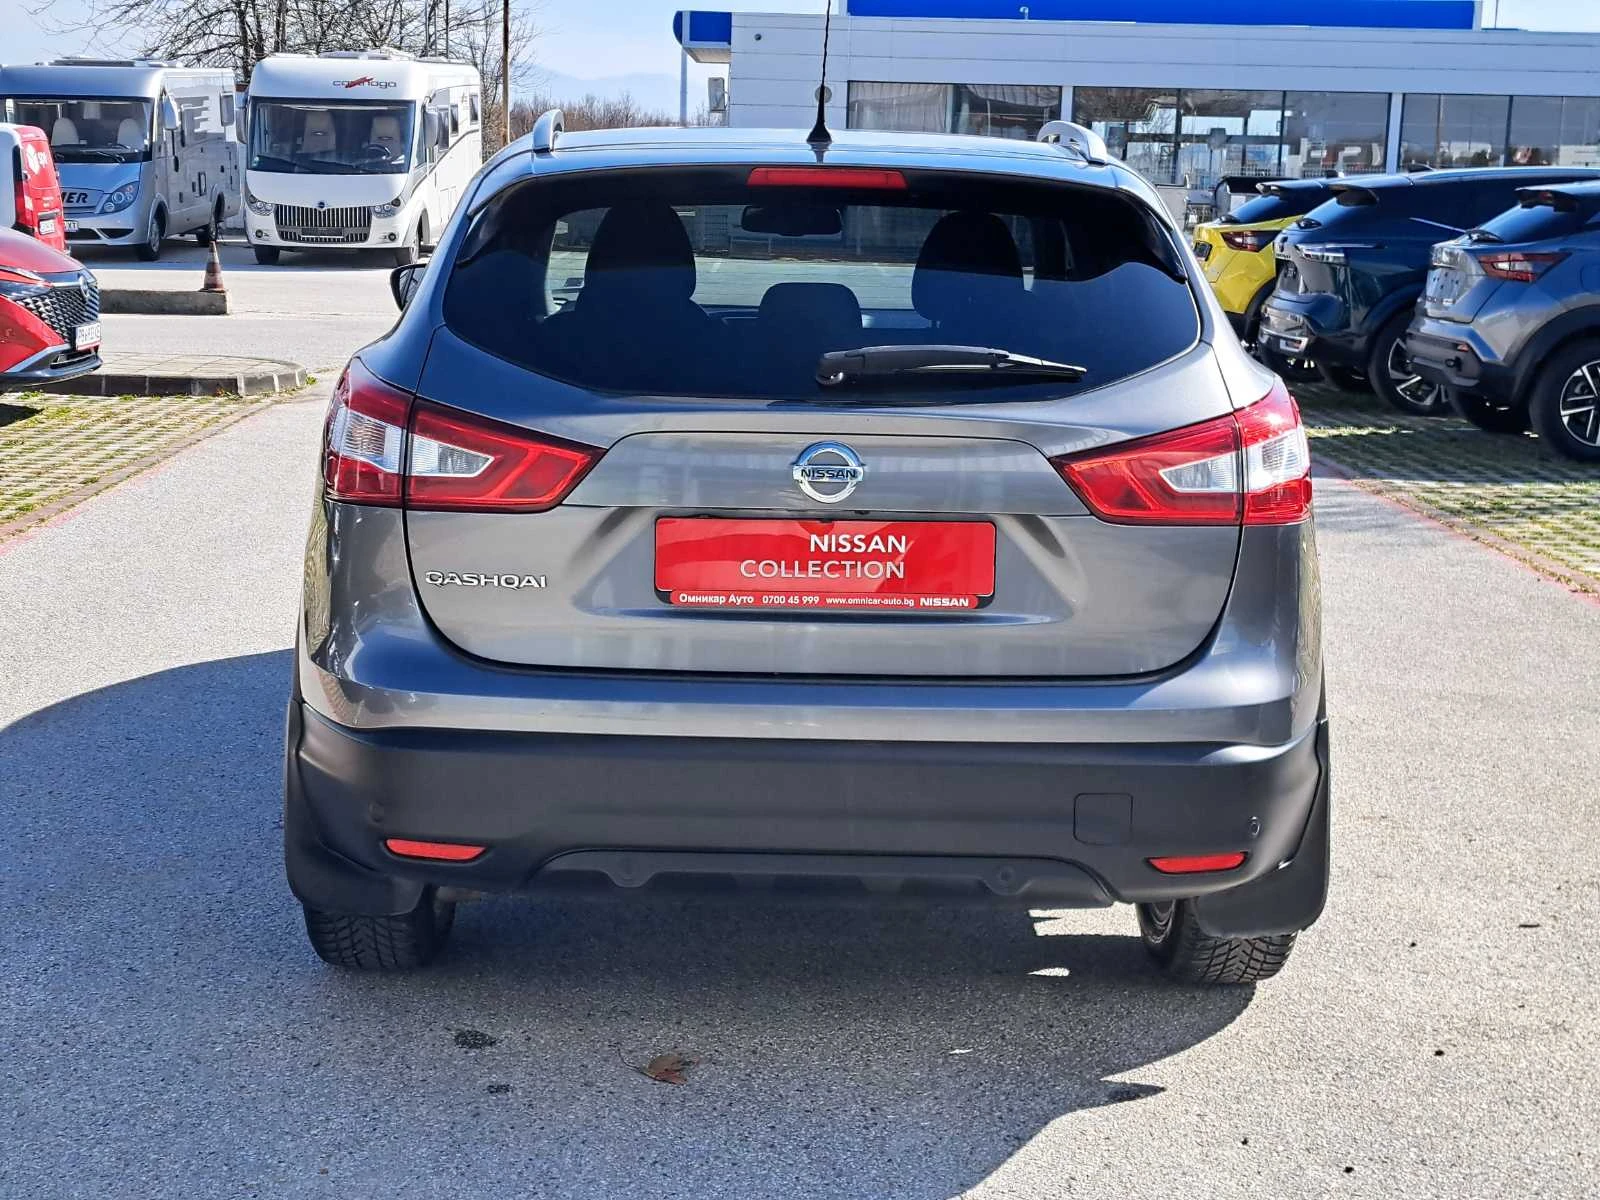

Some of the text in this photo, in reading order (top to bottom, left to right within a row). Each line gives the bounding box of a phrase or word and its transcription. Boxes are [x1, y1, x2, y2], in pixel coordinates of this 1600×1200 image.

[332, 77, 397, 89] cahago
[800, 468, 857, 479] NISSAN
[809, 533, 908, 554] NISSAN
[739, 559, 906, 579] COLLECTION
[424, 570, 548, 590] QASHQAI
[679, 593, 755, 606] Омникар Ауто
[762, 595, 820, 605] 0700 45 999
[825, 596, 915, 606] www.omnicar-auto.bg
[919, 597, 969, 606] NISSAN
